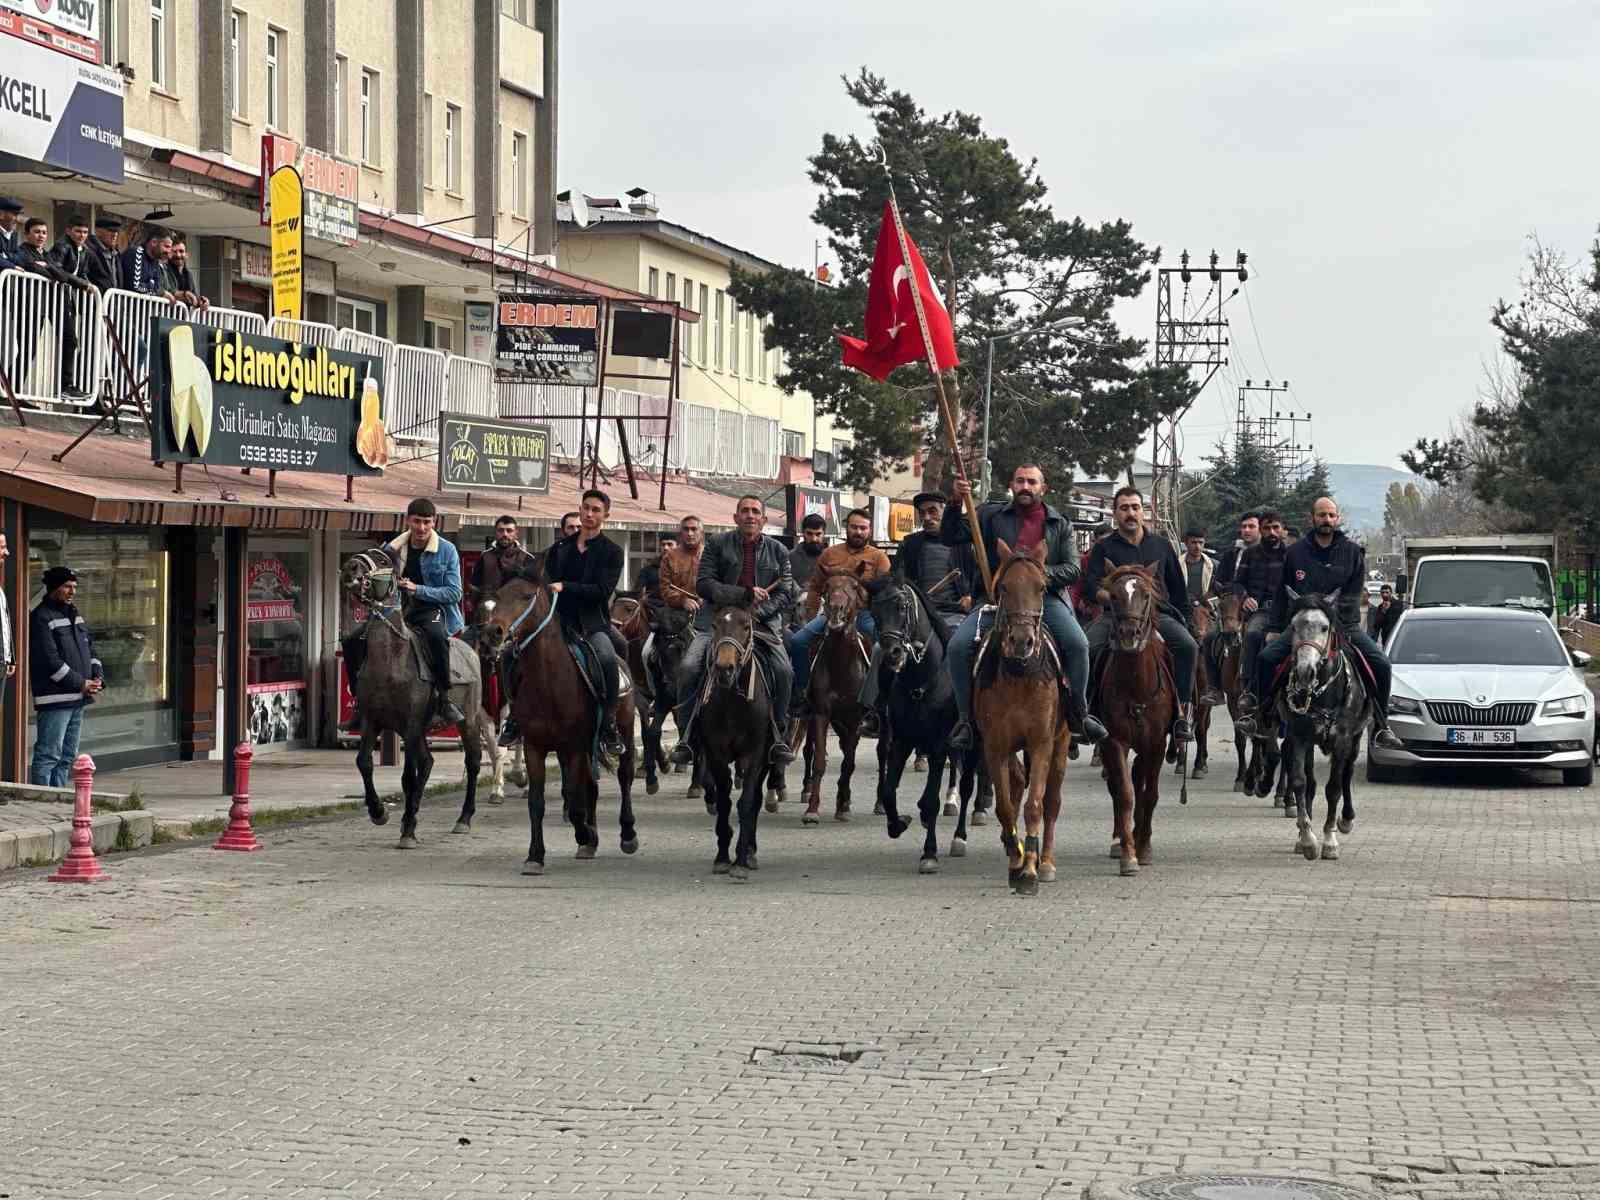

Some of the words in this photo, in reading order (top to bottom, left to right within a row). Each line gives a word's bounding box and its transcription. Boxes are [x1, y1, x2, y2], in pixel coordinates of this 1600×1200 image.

[80, 124, 97, 140] CENK
[304, 153, 357, 201] ERDEM
[500, 302, 597, 328] ERDEM
[500, 352, 525, 360] KEBAP
[514, 342, 532, 351] PİDE
[537, 343, 580, 353] LAHMACUN
[219, 405, 236, 433] Süt
[238, 403, 275, 442] Ürünleri
[276, 411, 300, 444] Satış
[301, 414, 337, 446] Mağazası
[240, 445, 267, 462] 0532
[269, 447, 288, 463] 335
[1472, 731, 1484, 742] AH
